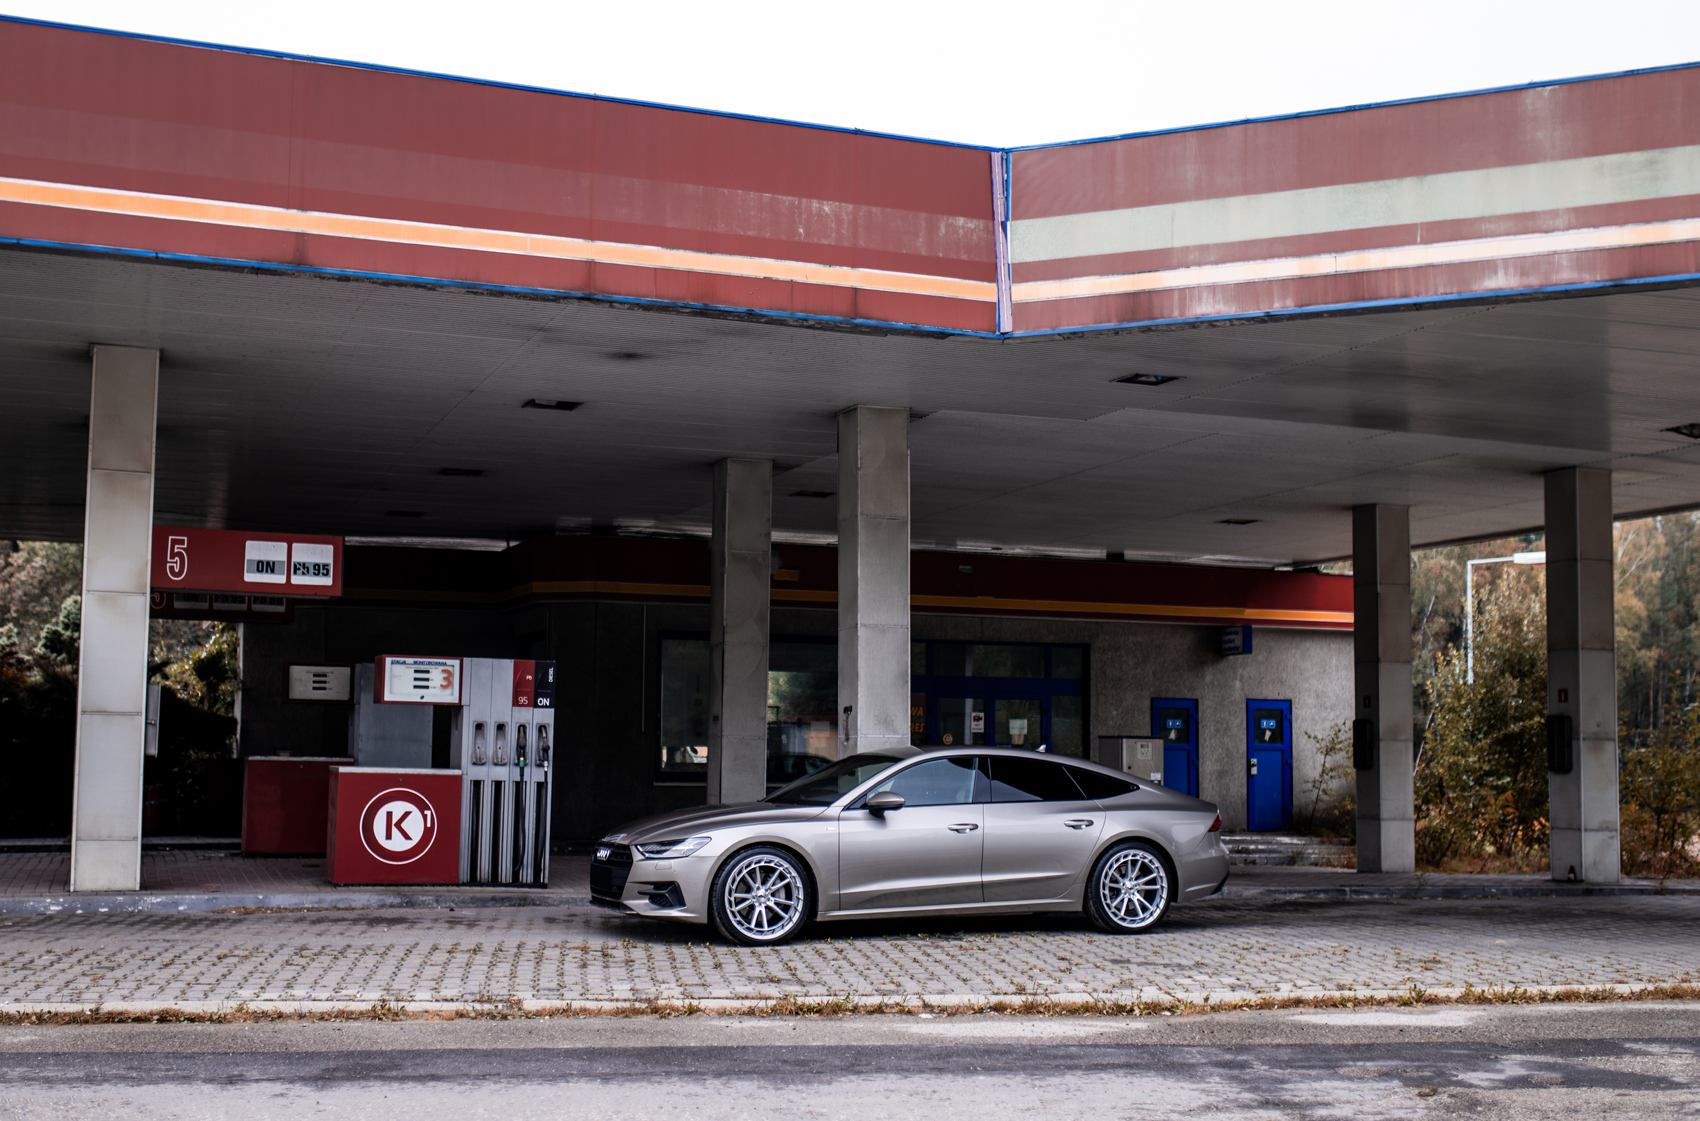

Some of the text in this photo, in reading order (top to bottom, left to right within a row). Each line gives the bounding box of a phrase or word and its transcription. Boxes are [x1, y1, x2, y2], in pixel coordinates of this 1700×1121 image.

[166, 536, 188, 581] 5
[256, 560, 275, 574] ON
[312, 563, 329, 577] 95
[440, 668, 453, 689] 3
[518, 696, 529, 705] 95
[537, 697, 550, 707] ON
